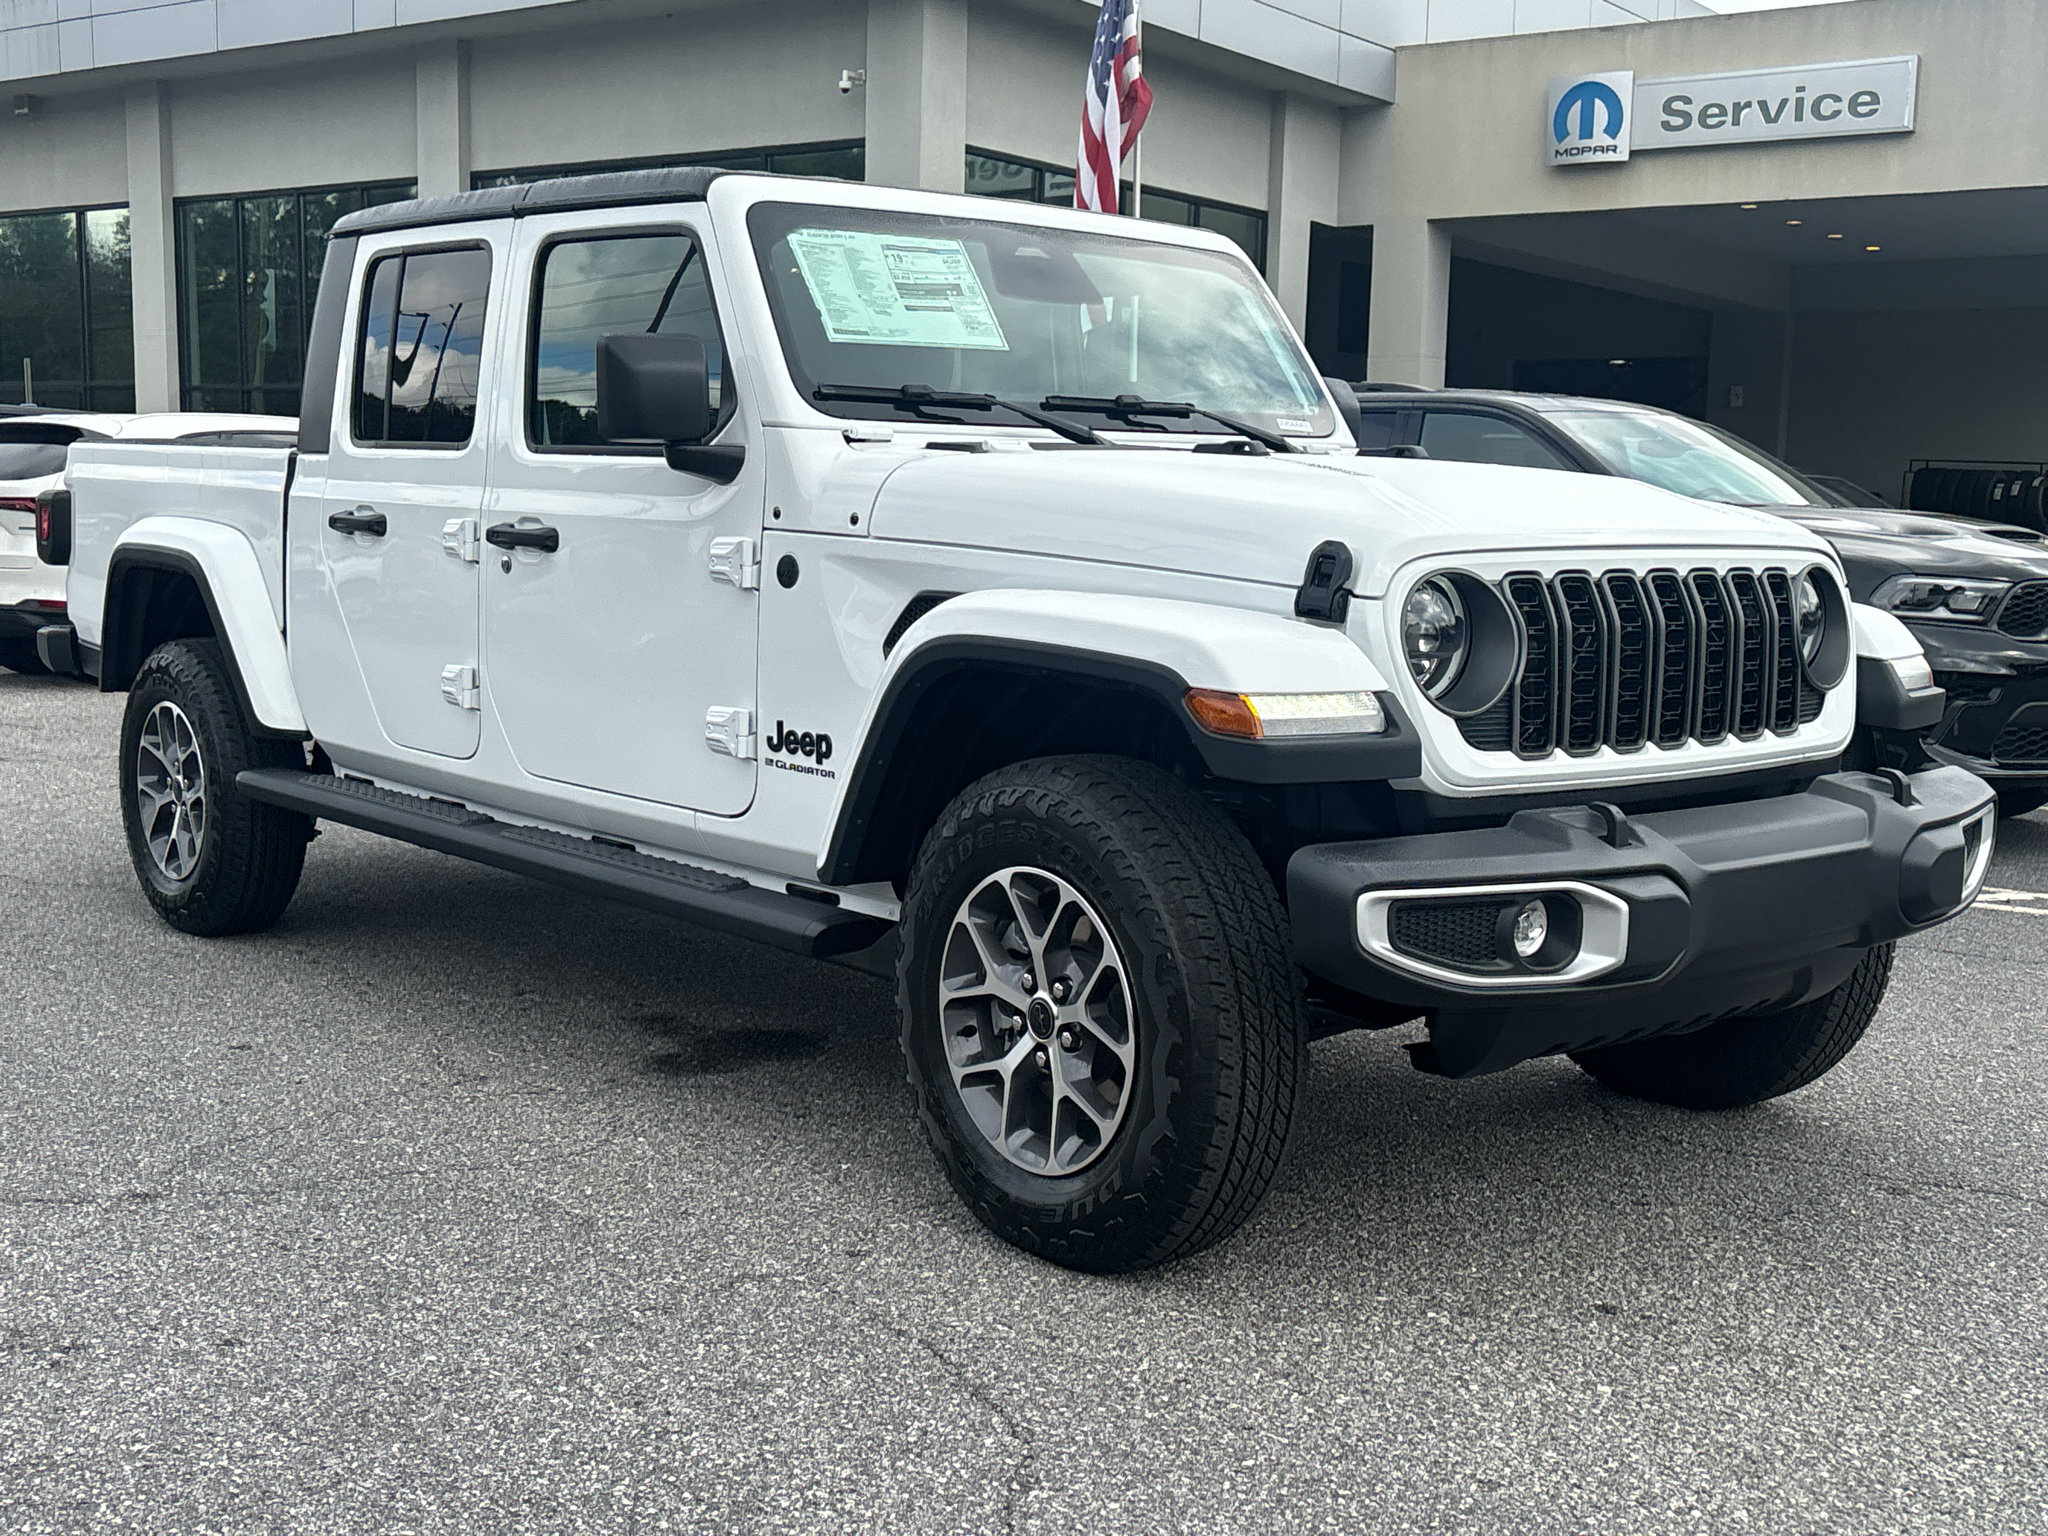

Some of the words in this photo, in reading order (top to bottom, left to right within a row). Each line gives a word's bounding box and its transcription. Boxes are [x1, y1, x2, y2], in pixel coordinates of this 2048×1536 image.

[1660, 85, 1881, 132] Service
[1554, 143, 1619, 159] MOPAR
[766, 719, 833, 765] Jeep
[775, 759, 836, 780] GLADIATOR
